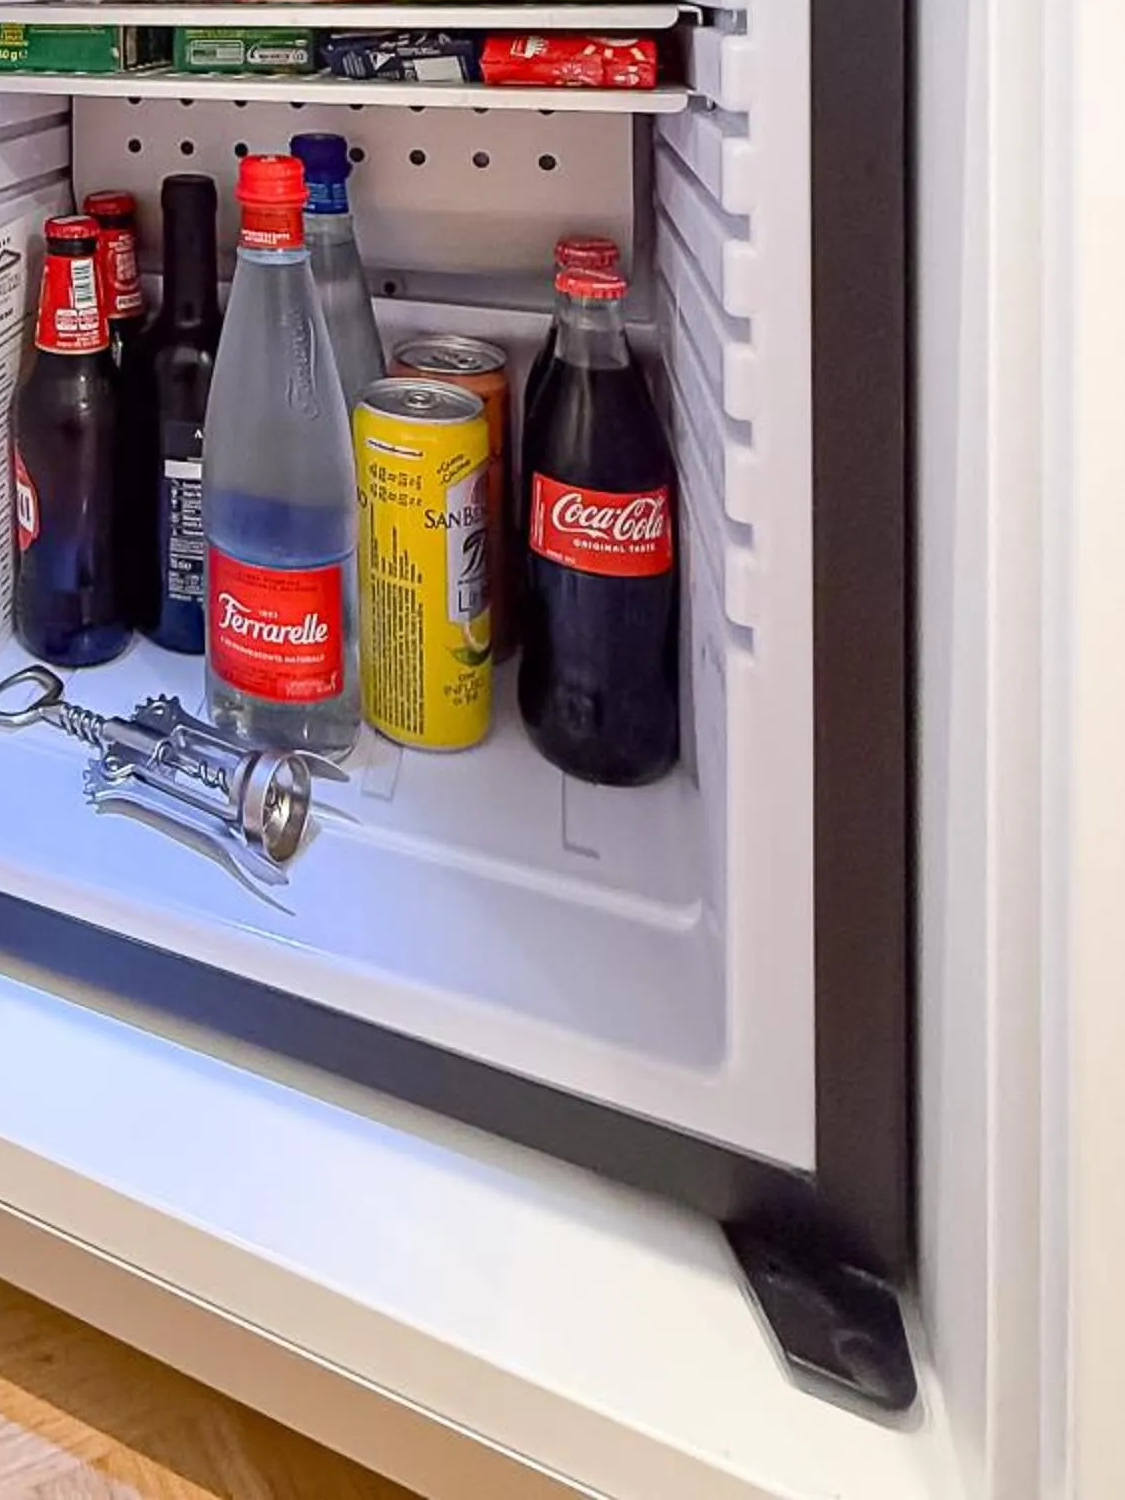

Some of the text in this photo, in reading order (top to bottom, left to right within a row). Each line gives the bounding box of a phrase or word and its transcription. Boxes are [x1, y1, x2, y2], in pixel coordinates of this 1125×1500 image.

[551, 493, 665, 541] Coca-Cola
[573, 538, 656, 554] ORIGINAL TASTE
[218, 592, 329, 645] Ferrarelle
